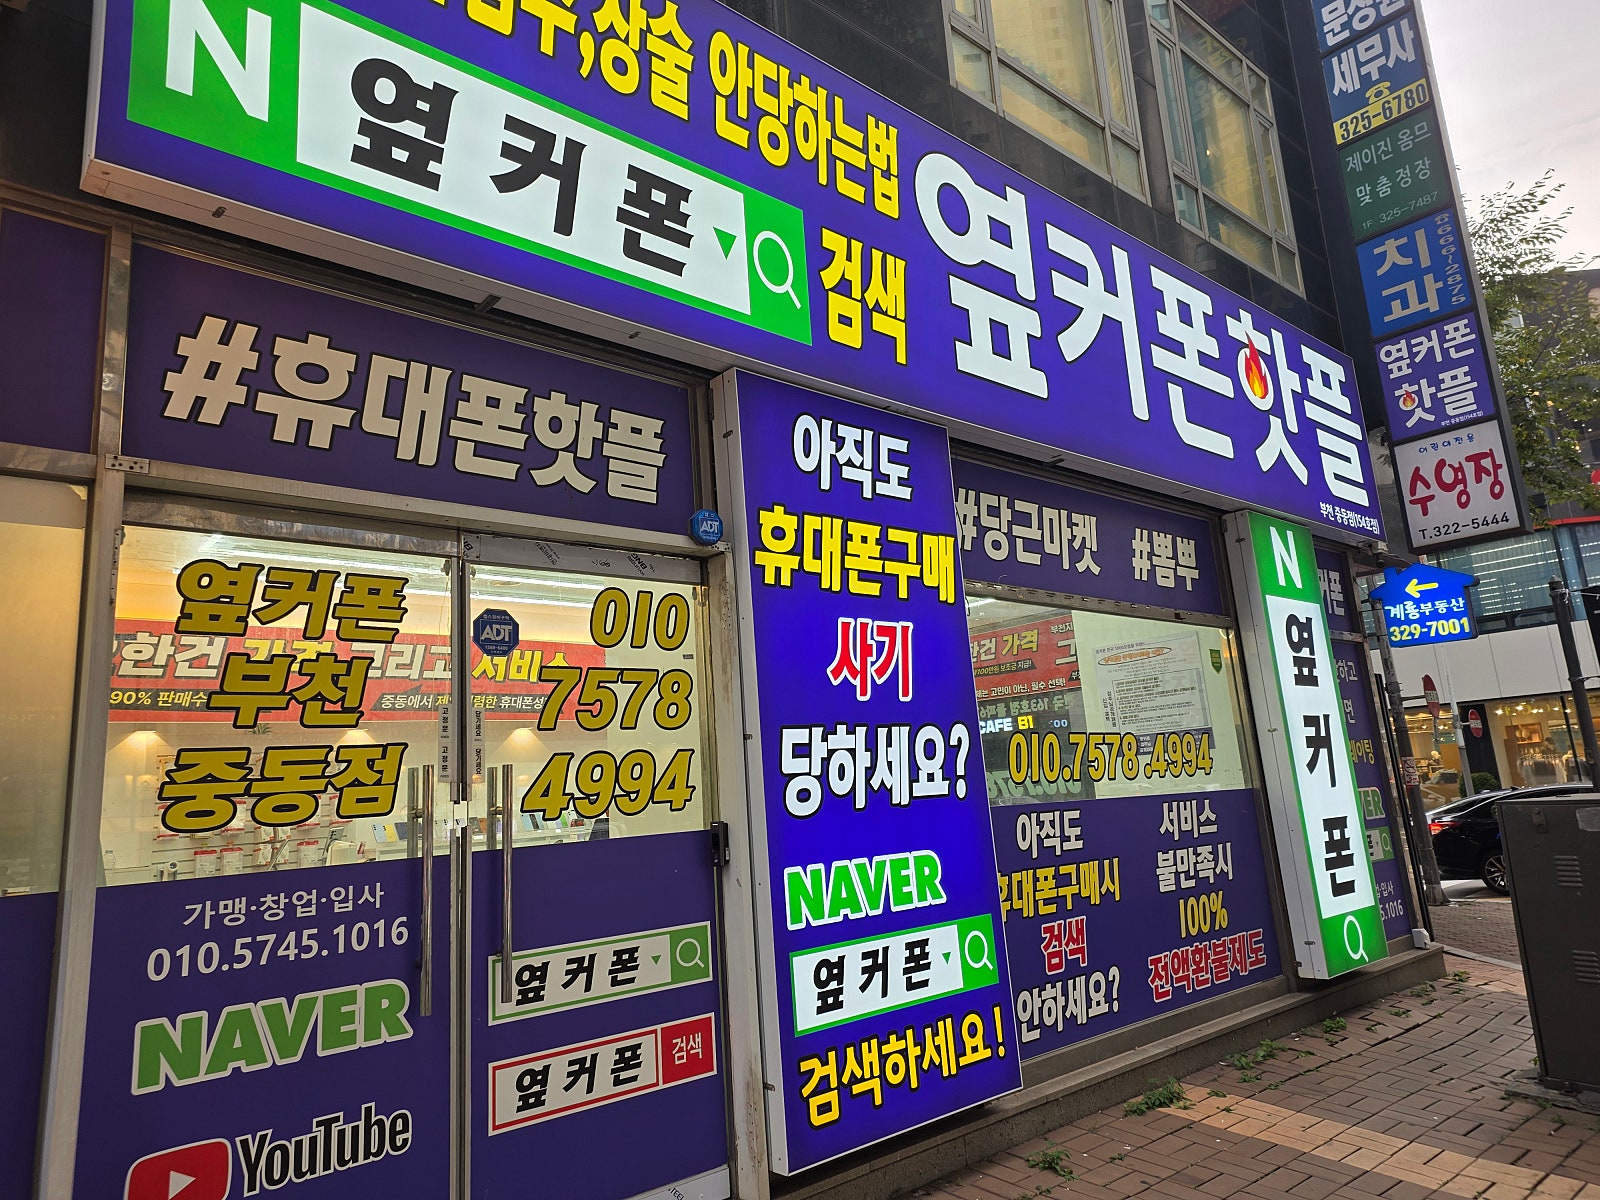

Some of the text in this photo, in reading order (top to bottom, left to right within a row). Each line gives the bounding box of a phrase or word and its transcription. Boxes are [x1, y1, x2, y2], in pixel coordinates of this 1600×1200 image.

[165, 0, 272, 122] N
[1331, 18, 1416, 96] 세무사
[709, 31, 900, 219] 안당하는법
[1339, 83, 1427, 141] 325-6780
[350, 58, 695, 277] 옆커폰
[1346, 121, 1432, 173] 제이진 옴므
[1379, 192, 1438, 224] 325-7487
[820, 227, 907, 365] 검색
[1373, 228, 1444, 323] 치과
[914, 152, 1369, 507] 옆커폰핫플
[1379, 318, 1476, 380] 옆커폰
[162, 314, 667, 504] #휴대폰핫플
[1394, 365, 1478, 428] 핫플
[793, 413, 912, 500] 아직도
[1409, 448, 1505, 517] 수영장
[700, 520, 719, 533] ADT
[754, 504, 957, 604] 휴대폰구매
[955, 487, 1199, 591] #당근마켓 #뽐뿌
[1270, 526, 1303, 589] N
[1419, 511, 1511, 540] T.322-5444
[176, 558, 409, 643] 옆커폰
[480, 624, 512, 642] ADT
[590, 586, 690, 651] 010
[1384, 597, 1466, 621] 계룡부동산
[1389, 617, 1471, 642] 329-7001
[827, 617, 913, 701] 사기
[1002, 629, 1039, 656] 가격
[109, 690, 151, 705] 90%
[205, 652, 374, 729] 부천
[380, 694, 433, 709] 중동에서
[472, 695, 498, 709] 렴한
[499, 695, 548, 710] 휴대폰성
[537, 666, 693, 731] 7578
[990, 686, 1011, 697] 고민이
[1017, 715, 1034, 730] B1
[157, 742, 409, 834] 중동점
[520, 748, 696, 822] 4994
[780, 722, 970, 817] 당하세요?
[1016, 810, 1084, 858] 아직도
[1159, 800, 1218, 841] 서비스
[784, 850, 947, 930] NAVER
[1156, 842, 1234, 893] 불만족시
[183, 882, 385, 930] 가맹·창업·입사
[1179, 890, 1229, 938] 100%
[147, 916, 409, 982] 010.5745.1016
[514, 946, 640, 1006] 옆커폰
[813, 937, 932, 1016] 옆커폰
[1041, 916, 1087, 975] 검색
[1148, 928, 1267, 1002] 전액환불제도
[131, 979, 414, 1095] NAVER
[1017, 966, 1121, 1043] 안하세요?
[515, 1032, 703, 1114] 옆커폰 검색
[799, 1005, 1006, 1128] 검색하세요!
[235, 1102, 412, 1198] YouTube
